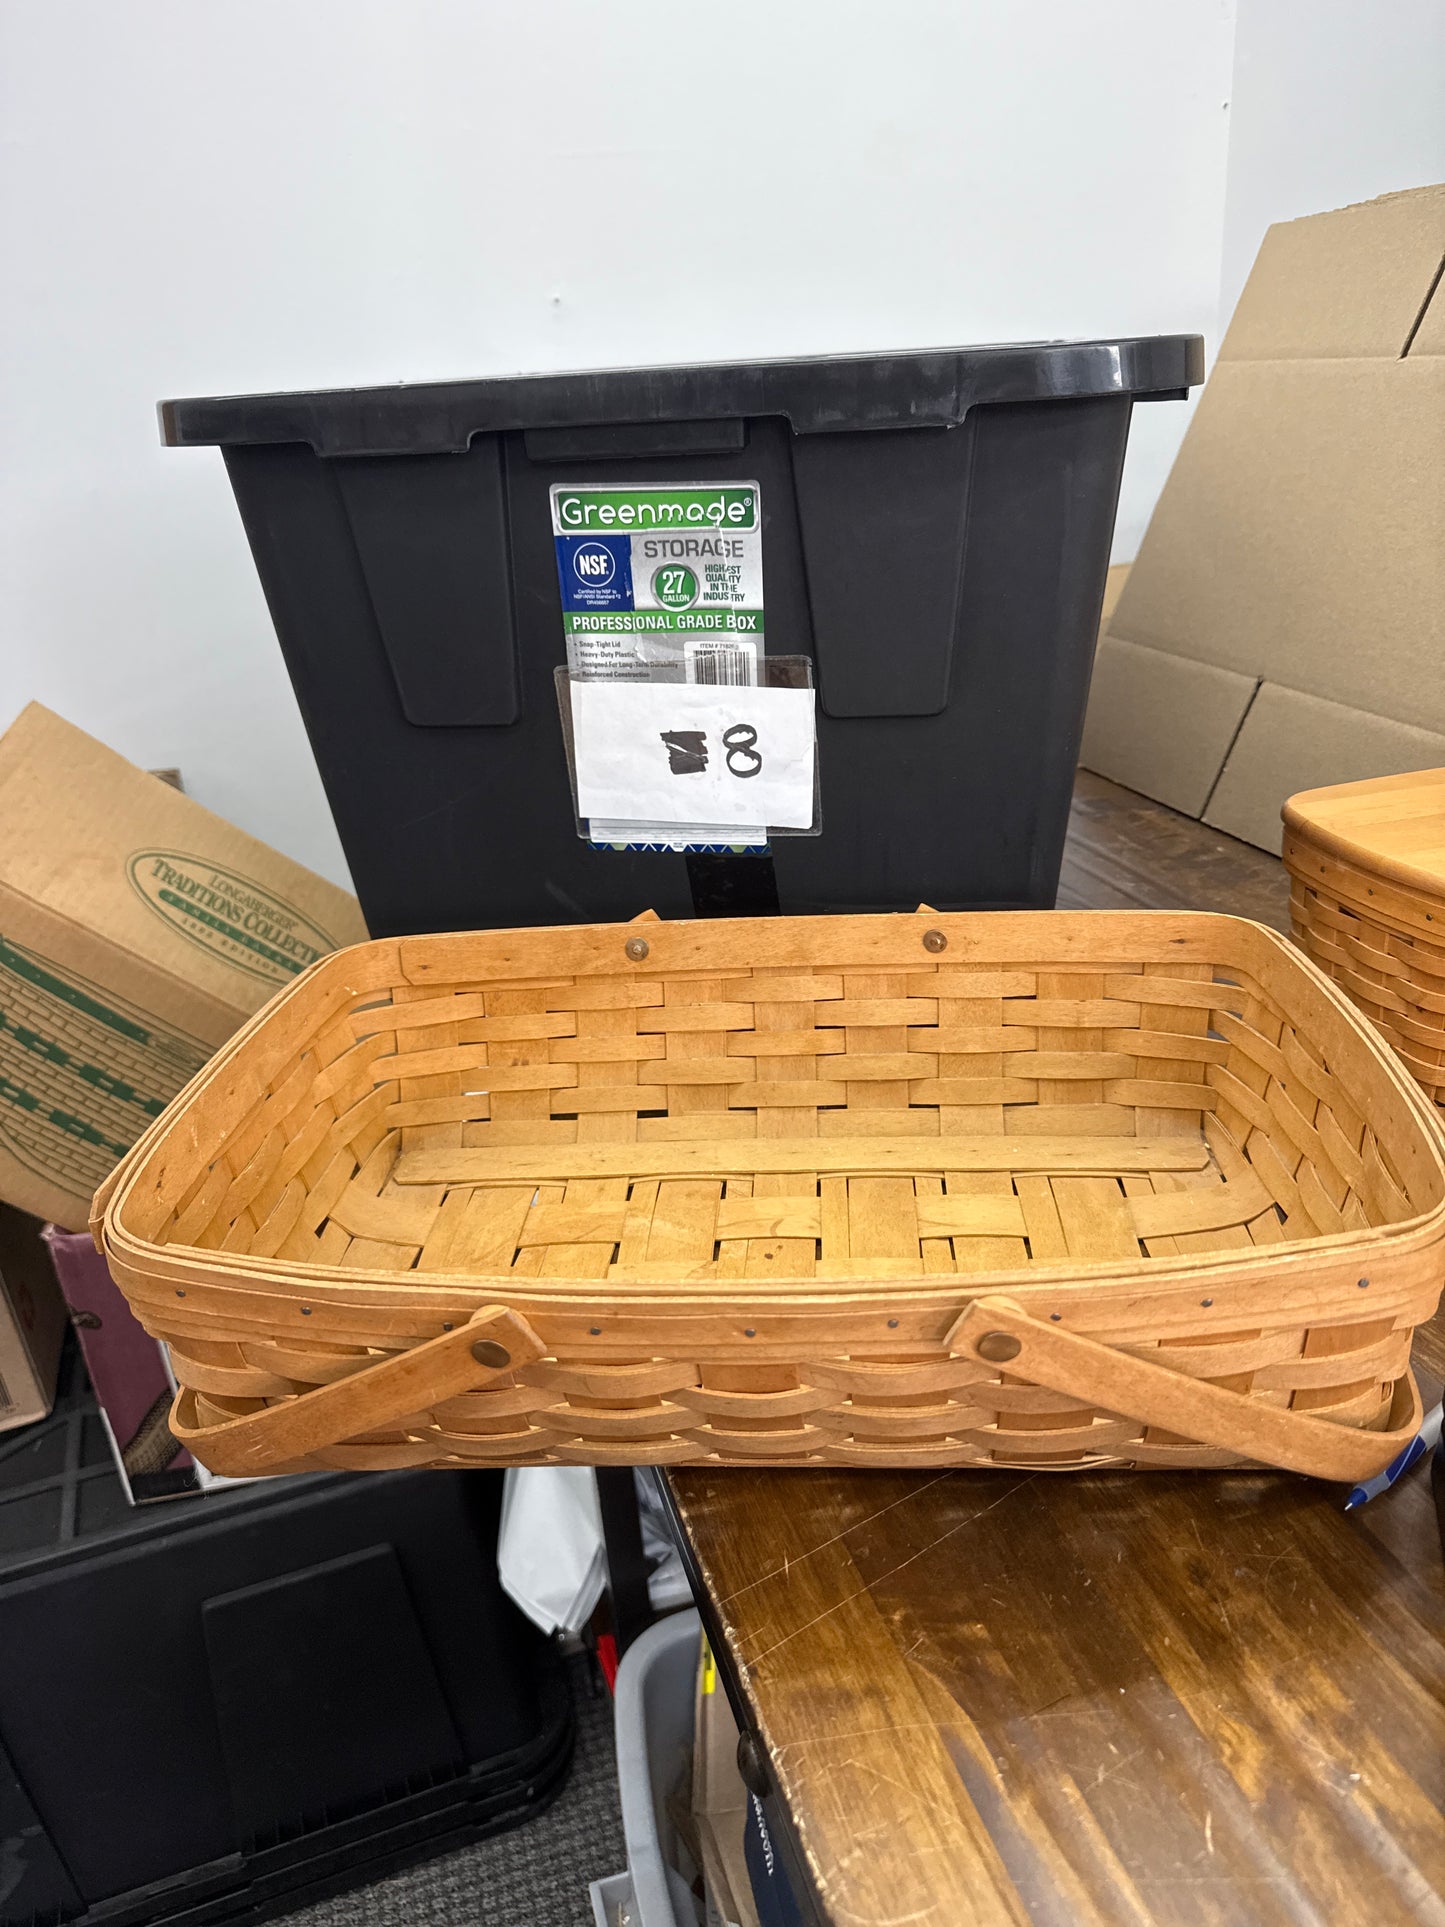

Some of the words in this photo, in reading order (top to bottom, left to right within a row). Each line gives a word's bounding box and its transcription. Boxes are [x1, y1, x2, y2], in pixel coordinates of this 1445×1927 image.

[644, 538, 744, 559] STORAGE
[579, 555, 608, 575] NSF
[662, 570, 685, 594] 27
[705, 573, 741, 584] QUALITY
[710, 583, 720, 592] IN
[720, 583, 738, 593] THE
[662, 594, 690, 602] GALLON
[703, 592, 745, 602] INDUSTRY
[572, 615, 674, 631] PROFESSIONAL
[677, 614, 723, 629] GRADE
[726, 614, 756, 630] BOX
[579, 641, 611, 649] Snap-Tight
[581, 661, 607, 669] Designed
[722, 723, 762, 778] 8
[151, 858, 244, 924] TRADITIONS
[243, 908, 325, 964] COLLECTI
